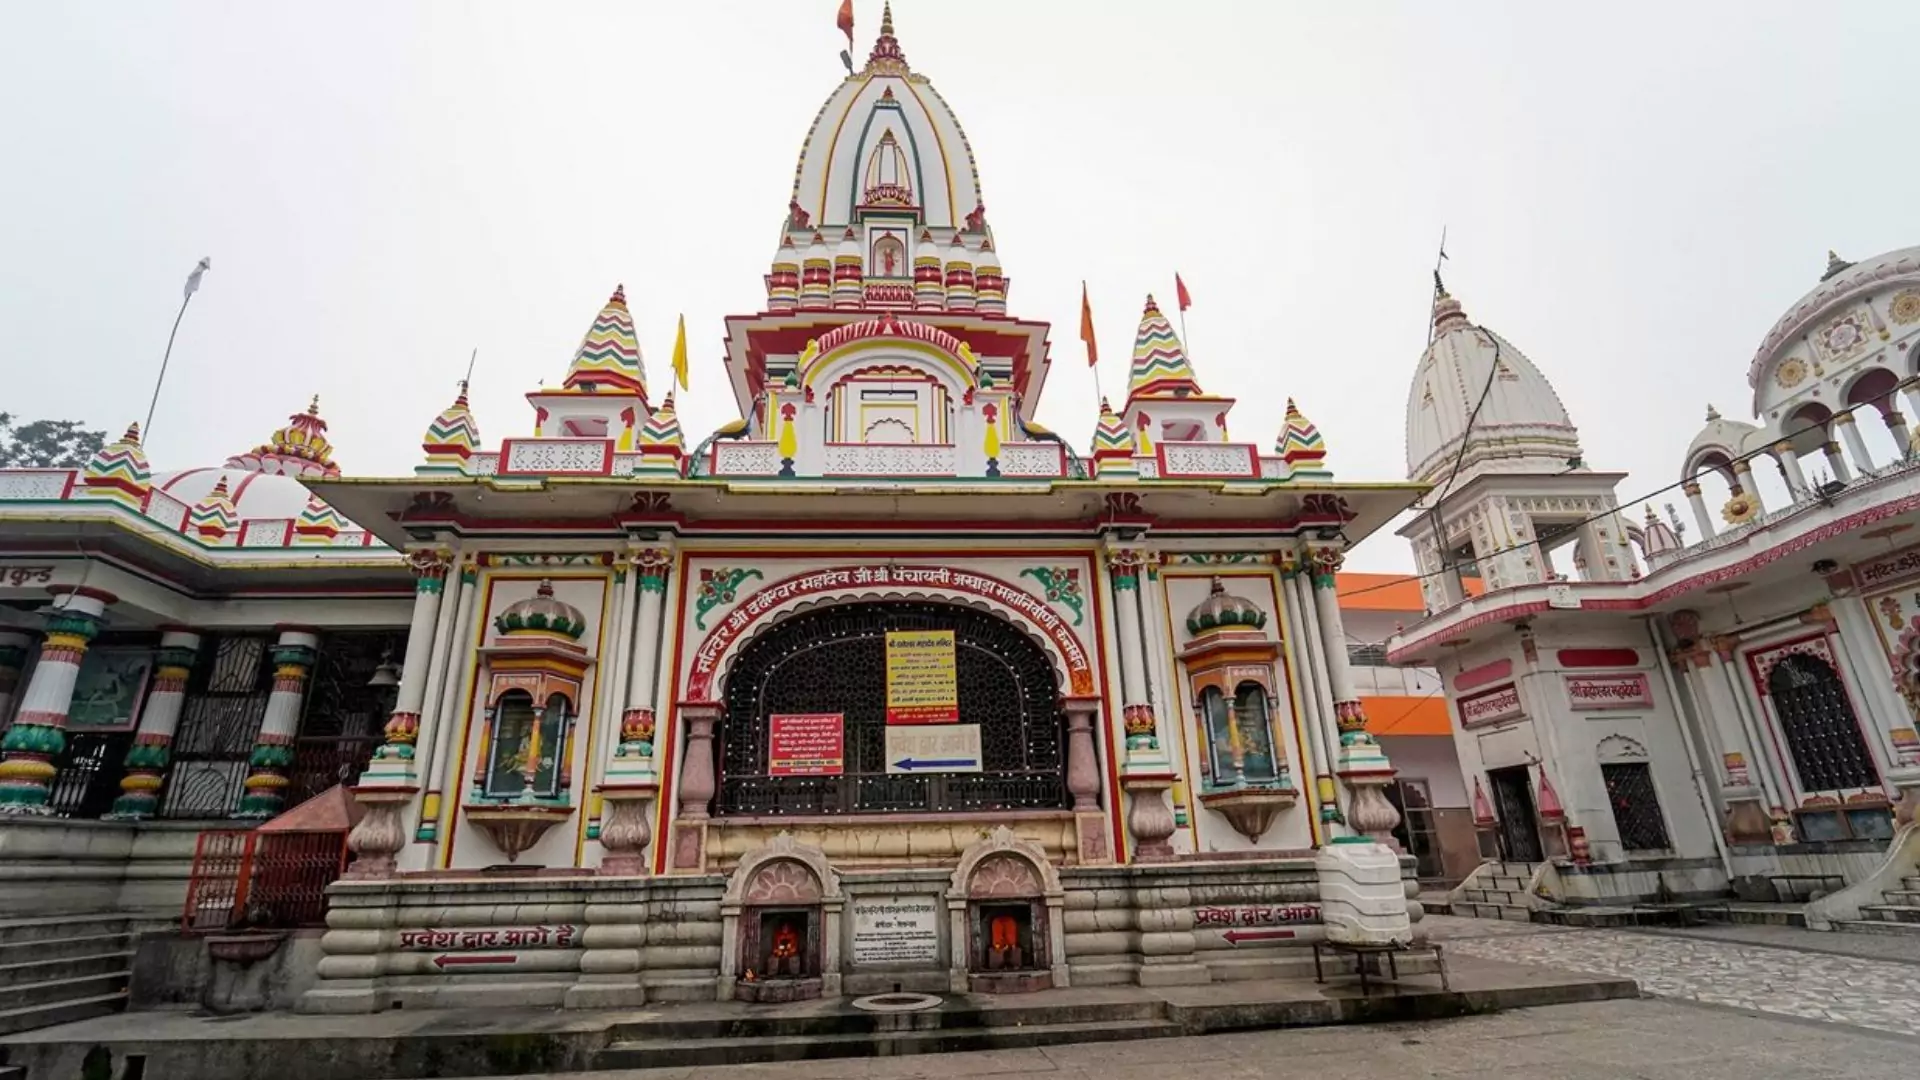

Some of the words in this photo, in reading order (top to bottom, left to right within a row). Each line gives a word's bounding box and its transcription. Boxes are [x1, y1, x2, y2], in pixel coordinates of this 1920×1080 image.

[729, 607, 749, 630] श्री
[800, 569, 849, 590] महादेव
[852, 567, 871, 583] जी
[873, 568, 890, 583] श्री
[893, 565, 951, 584] पंचायती
[1194, 905, 1236, 925] प्रवेश
[1240, 906, 1273, 926] द्वार
[1276, 903, 1321, 924] आगे
[400, 928, 456, 948] प्रवेश
[461, 930, 499, 949] द्वार
[501, 925, 552, 947] आगे
[556, 924, 576, 947] है
